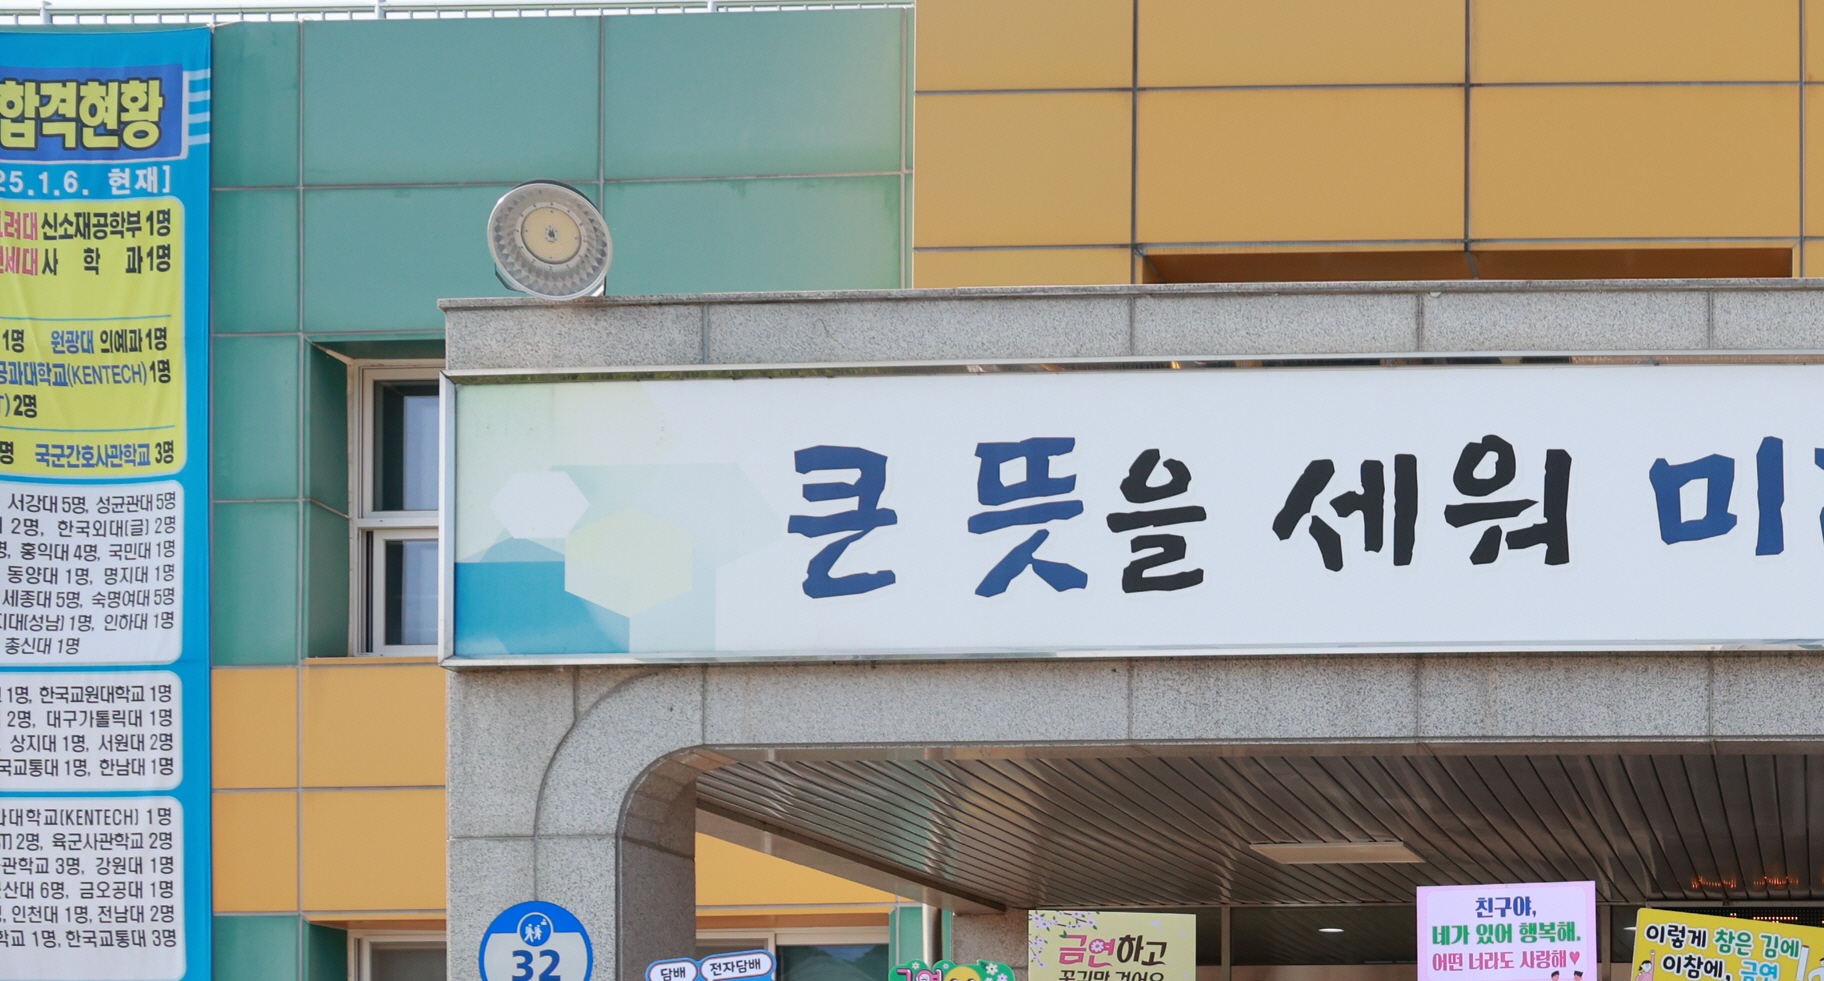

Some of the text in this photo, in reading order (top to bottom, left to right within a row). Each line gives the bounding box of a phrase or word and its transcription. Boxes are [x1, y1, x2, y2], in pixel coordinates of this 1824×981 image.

[0, 78, 163, 150] 합격현황
[108, 165, 170, 195] 현재]
[41, 209, 170, 240] 신소재공학부 1명
[51, 327, 167, 354] 원광대 의예과 1명
[35, 440, 174, 468] 국군간호사관학교 3명
[8, 491, 176, 515] 서강대 5명, 성균관대 5명
[154, 515, 176, 534] 2명
[788, 445, 898, 599] 큰
[968, 438, 1207, 598] 뜻을
[1272, 434, 1572, 572] 세워
[104, 611, 174, 631] 인하대 1명
[40, 684, 172, 703] 한국교원대학교 1명
[80, 880, 173, 899] 금오공대 1명
[1474, 895, 1537, 919] 친구야,
[65, 929, 176, 948] 한국교통대 3명
[1432, 920, 1581, 946] 네가 있어 행복해.
[1645, 924, 1801, 960] 이렇게 참은 김에
[1058, 934, 1168, 968] 금연하고
[1432, 948, 1568, 972] 어떤 너라도 사랑해
[660, 958, 761, 981] 담배 전자담배
